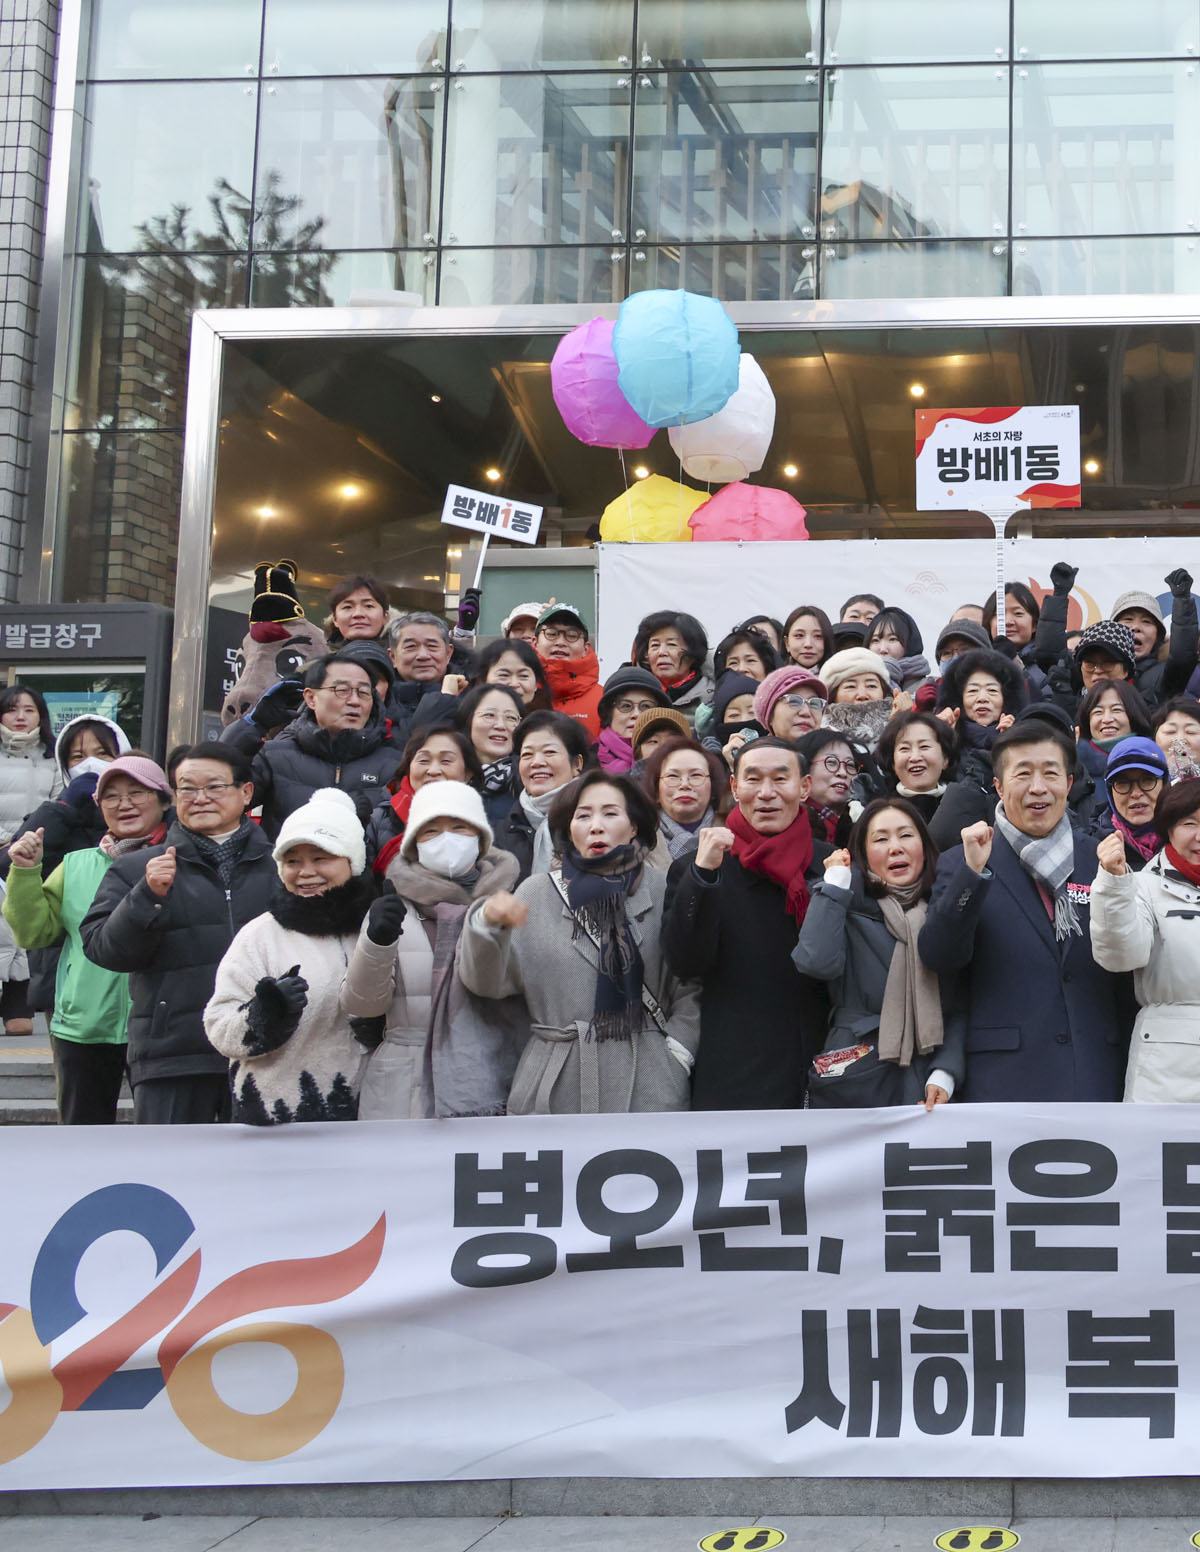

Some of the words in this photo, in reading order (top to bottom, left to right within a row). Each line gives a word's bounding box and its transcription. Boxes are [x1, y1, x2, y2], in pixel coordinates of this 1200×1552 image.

[973, 431, 1001, 442] 서초의
[1003, 430, 1023, 441] 자랑
[936, 445, 1060, 483] 방배1동
[452, 495, 533, 534] 방배1동
[0, 624, 102, 649] 발급창구
[363, 774, 377, 782] K2
[451, 1145, 843, 1288] 병오년,
[882, 1139, 1120, 1273] 붉은
[785, 1304, 1026, 1438] 새해
[1065, 1309, 1179, 1440] 복
